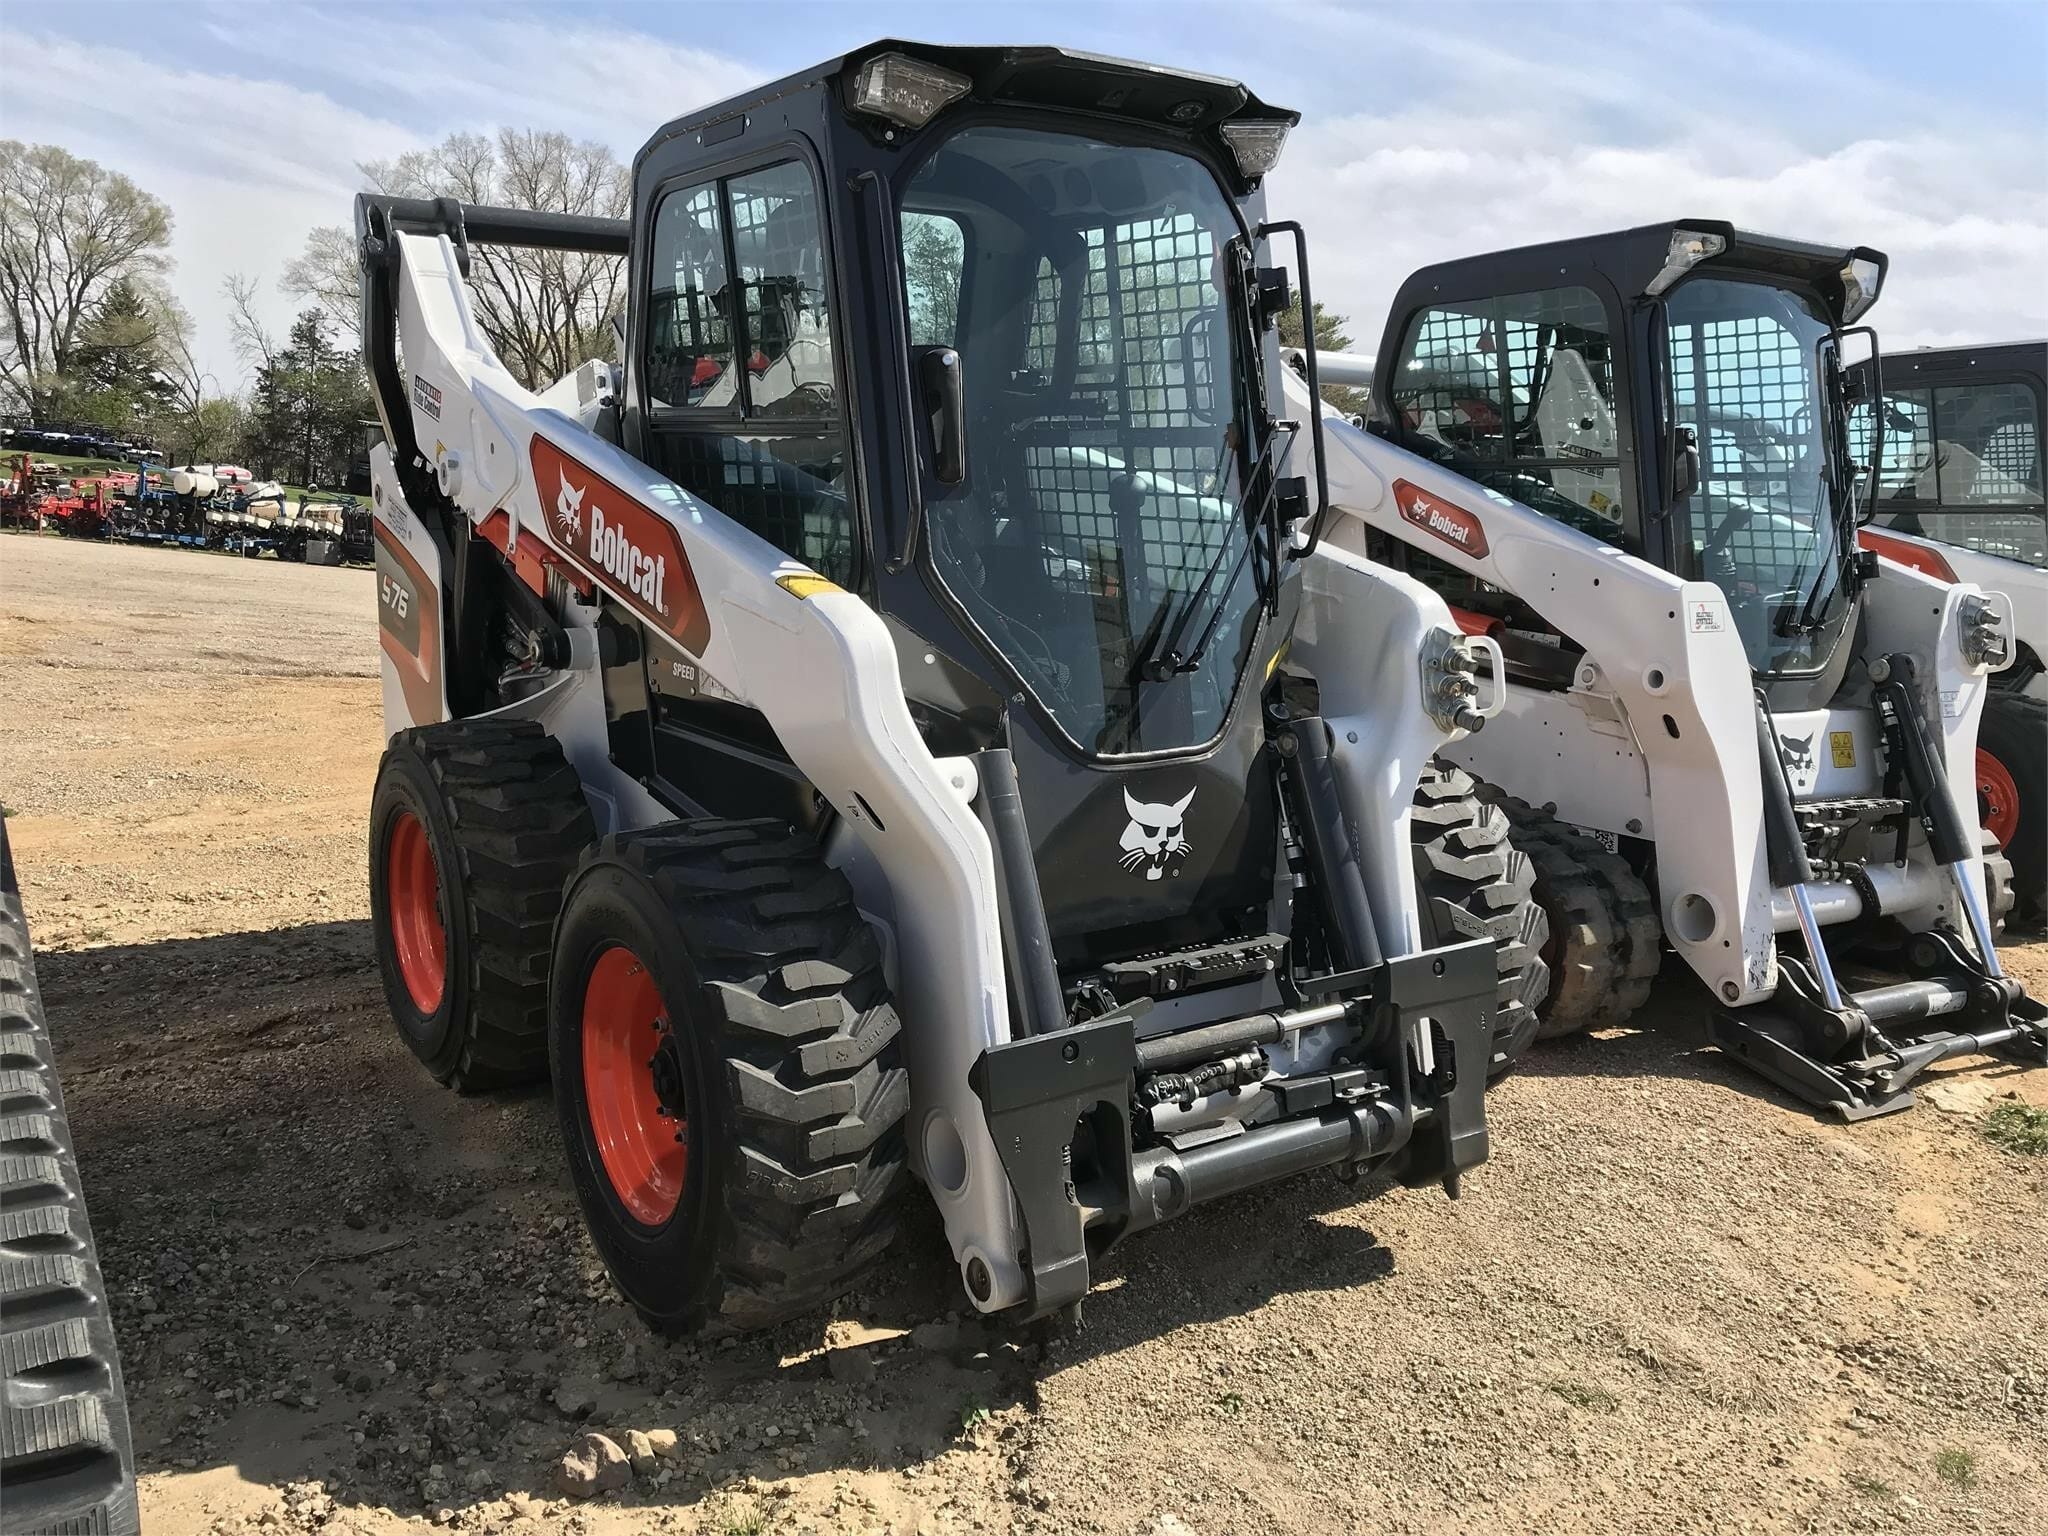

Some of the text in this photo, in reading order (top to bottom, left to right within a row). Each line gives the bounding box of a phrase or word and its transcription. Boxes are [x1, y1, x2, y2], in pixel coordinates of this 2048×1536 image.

[1428, 509, 1470, 544] Bobcat
[589, 503, 666, 614] Bobcat
[381, 574, 409, 619] S76
[672, 662, 695, 681] SPEED
